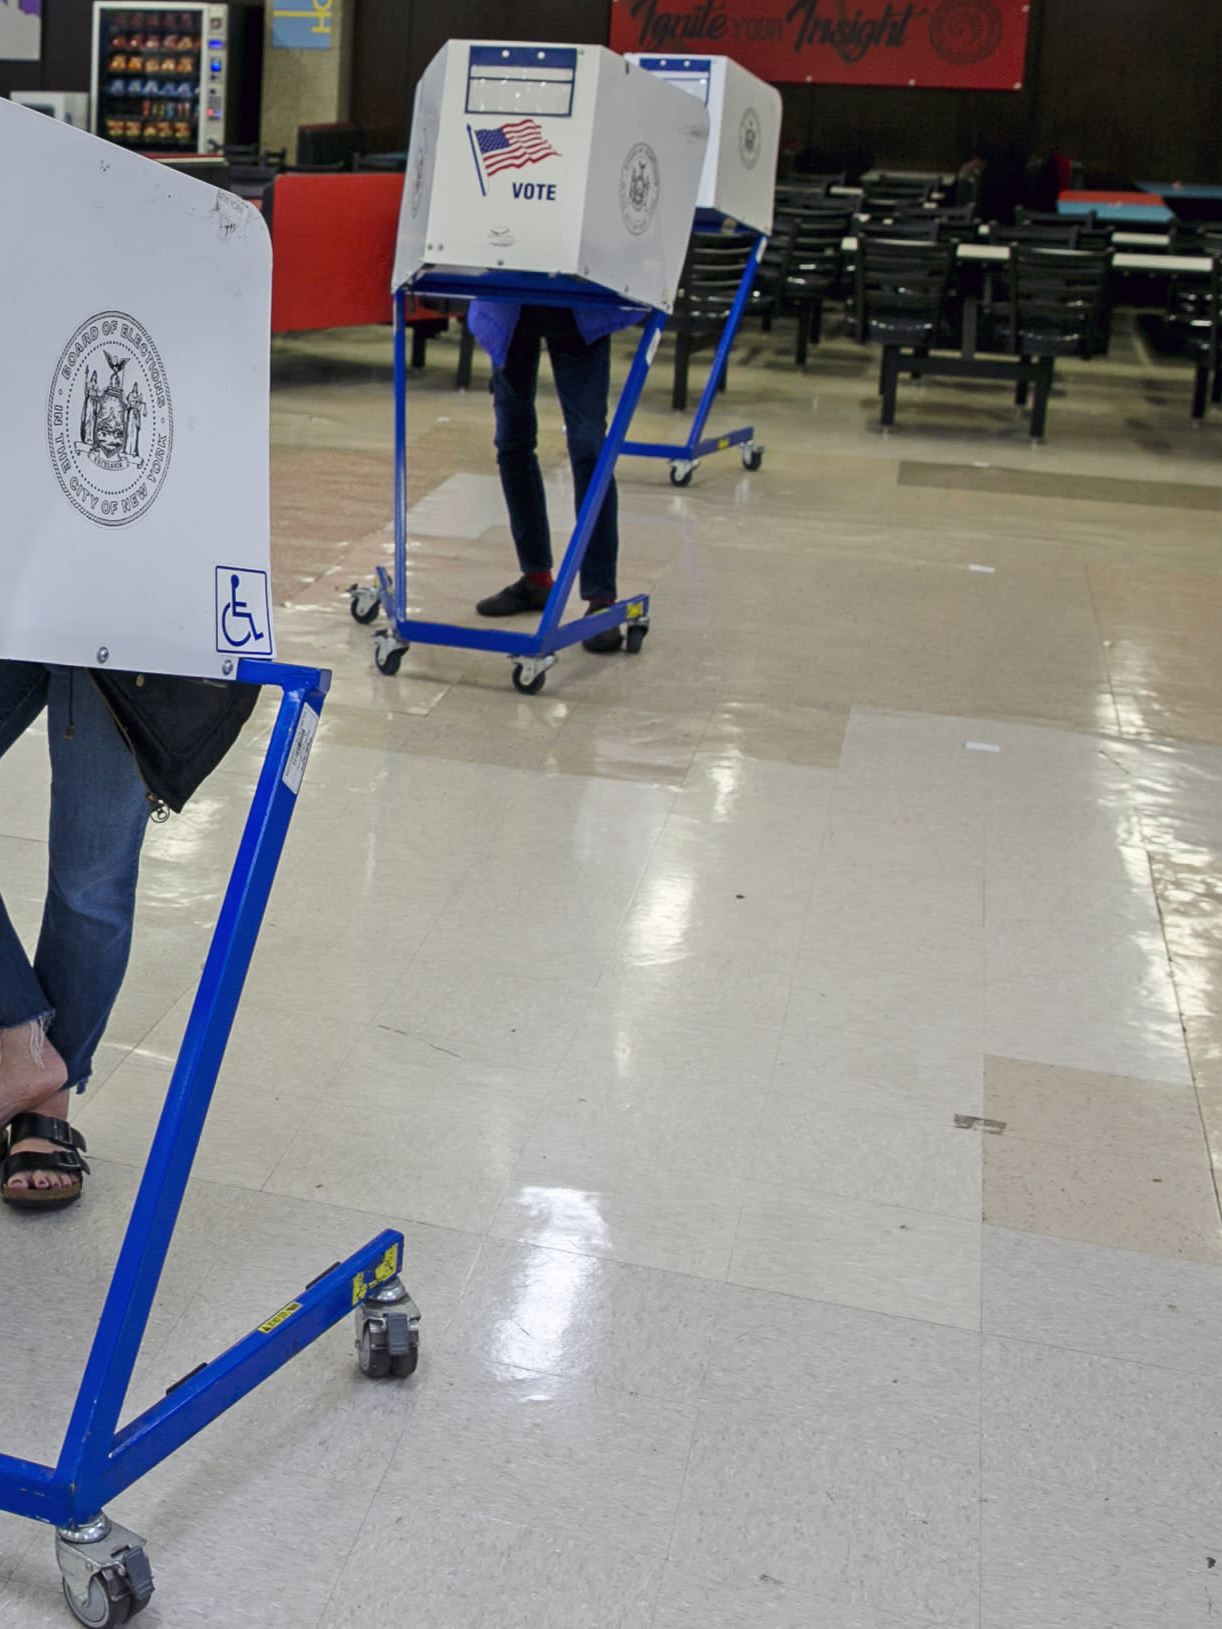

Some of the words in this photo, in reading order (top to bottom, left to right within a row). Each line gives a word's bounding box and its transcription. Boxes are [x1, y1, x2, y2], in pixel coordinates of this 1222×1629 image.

[512, 182, 557, 201] VOTE
[62, 326, 99, 381] BOARD
[101, 320, 118, 337] OF
[120, 323, 166, 409] ELECTIONS
[53, 404, 64, 426] IN
[54, 432, 71, 475] THE
[147, 433, 167, 484] YORK
[69, 476, 99, 510] CITY
[101, 499, 118, 515] OF
[121, 482, 149, 514] NEW
